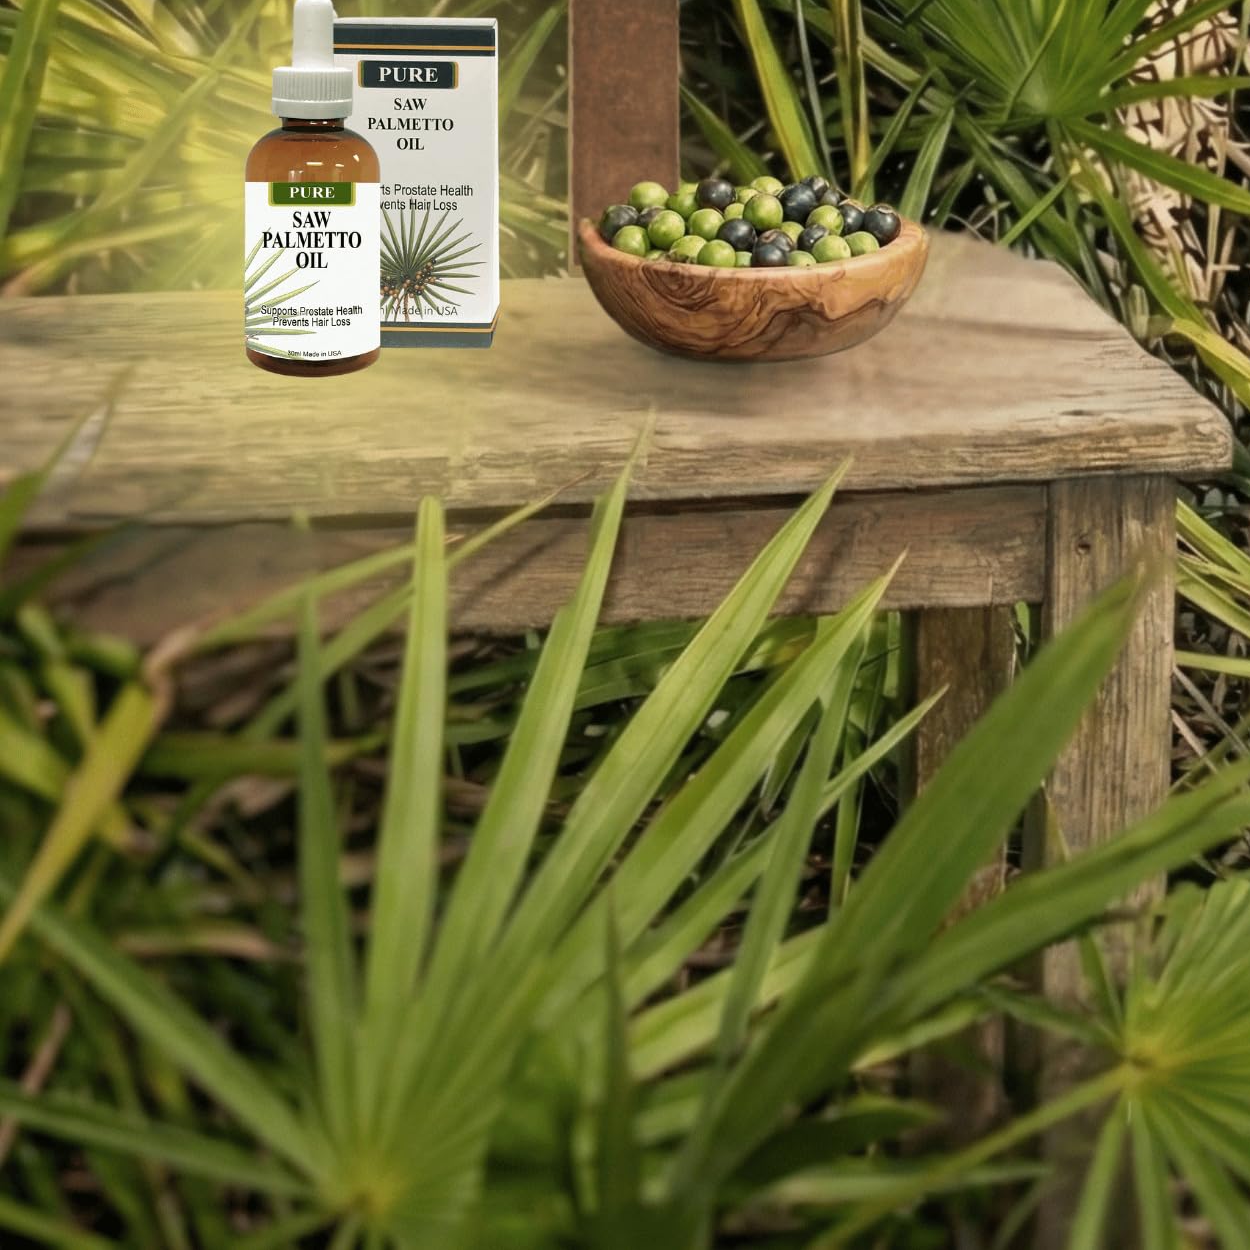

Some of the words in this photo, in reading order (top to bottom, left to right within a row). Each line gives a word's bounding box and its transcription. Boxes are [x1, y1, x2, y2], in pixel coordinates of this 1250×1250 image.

[378, 66, 439, 83] PURE
[393, 97, 428, 111] SAW
[367, 116, 455, 131] PALMETTO
[396, 137, 425, 151] OIL
[289, 186, 336, 199] PURE
[394, 183, 438, 196] Prostate
[439, 184, 474, 197] Health
[409, 198, 431, 211] Hair
[433, 198, 458, 211] Loss
[292, 210, 332, 229] SAW
[261, 230, 362, 249] PALMETTO
[295, 251, 329, 269] OIL
[260, 304, 298, 317] Supports
[299, 306, 334, 316] Prostate
[336, 305, 364, 316] Health
[424, 305, 434, 316] in
[436, 306, 459, 317] USA
[272, 316, 310, 327] Prevents
[311, 317, 330, 327] Hair
[331, 317, 351, 327] Loss
